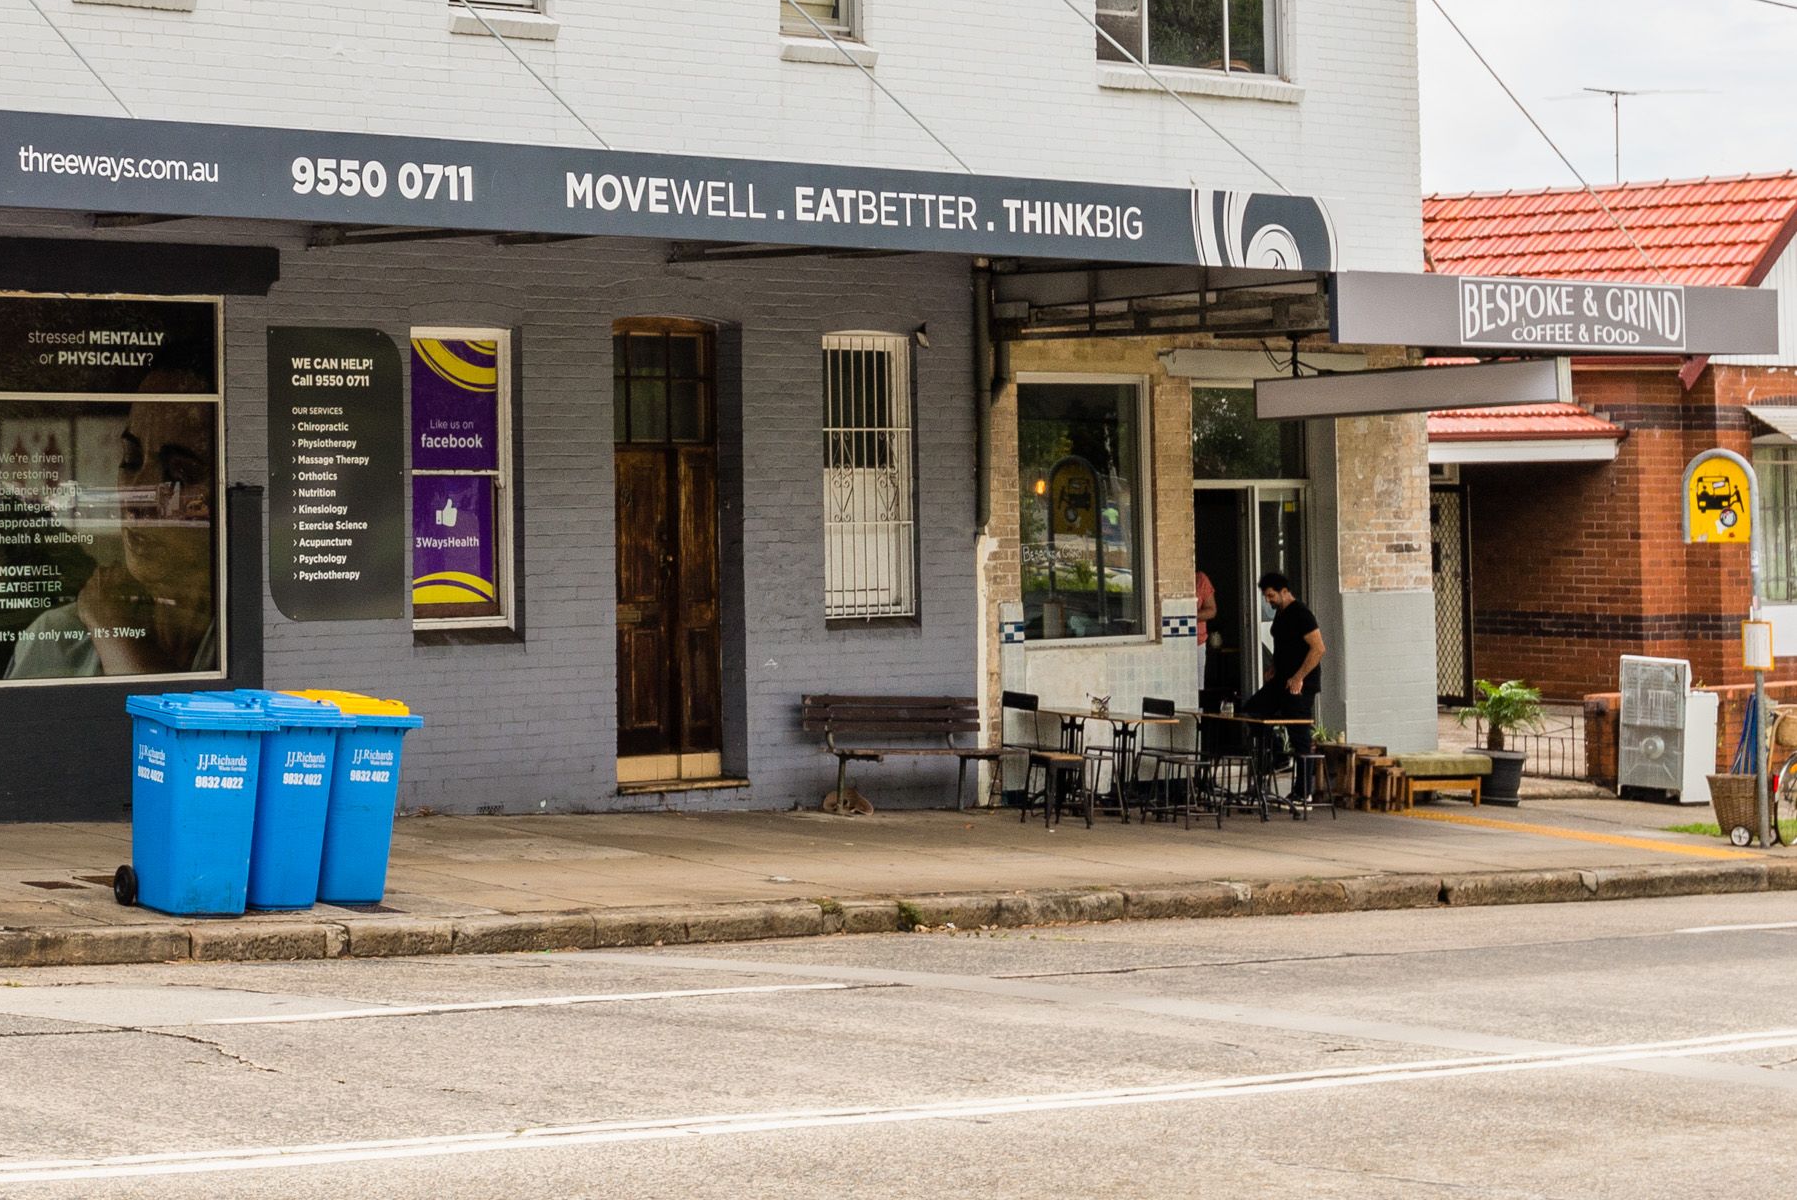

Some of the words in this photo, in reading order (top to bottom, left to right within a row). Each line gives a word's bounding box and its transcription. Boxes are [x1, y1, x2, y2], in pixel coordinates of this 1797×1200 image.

[18, 145, 219, 182] threeways.com.au
[291, 156, 387, 198] 9550
[398, 163, 473, 201] 0711
[566, 172, 766, 219] MOVEWELL
[796, 186, 977, 231] EATBETTER
[1003, 200, 1143, 240] THINKBIG
[1464, 283, 1575, 339] BESPOKE
[1583, 287, 1599, 317] &
[1605, 288, 1681, 342] GRIND
[28, 330, 85, 344] stressed
[89, 331, 164, 346] MENTALLY
[1512, 323, 1573, 342] COFFEE
[1579, 323, 1589, 343] &
[1594, 325, 1640, 344] FOOD
[39, 353, 54, 365] or
[58, 351, 154, 367] PHYSICALLY?
[291, 357, 311, 369] WE
[313, 358, 338, 369] CAN
[341, 358, 373, 370] HELP!
[291, 374, 313, 386] Call
[315, 375, 344, 387] 9550
[346, 375, 370, 387] 0711
[291, 406, 308, 415] OUR
[309, 406, 343, 415] SERVICES
[297, 421, 349, 433] Chiropractic
[429, 419, 448, 430] Like
[450, 421, 460, 430] us
[462, 420, 474, 430] on
[297, 438, 357, 450] Physiotherapy
[421, 433, 483, 449] facebook
[31, 452, 64, 463] driven
[298, 455, 334, 466] Massage
[335, 455, 370, 466] Therapy
[12, 469, 59, 481] restoring
[298, 471, 338, 481] Orthotics
[298, 488, 337, 498] Nutrition
[298, 504, 348, 516] Kinesiology
[50, 518, 62, 528] to
[298, 520, 334, 531] Exercise
[335, 520, 368, 530] Science
[34, 533, 42, 543] &
[44, 532, 94, 545] wellbeing
[298, 537, 353, 549] Acupuncture
[415, 536, 480, 550] 3WaysHealth
[299, 553, 347, 566] Psychology
[0, 564, 62, 577] MOVEWELL
[299, 570, 361, 582] Psychotherapy
[0, 580, 62, 593] EATBETTER
[0, 597, 52, 609] THINKBIG
[0, 631, 15, 642] It's
[18, 630, 35, 641] the
[38, 629, 61, 642] only
[64, 629, 84, 642] way
[94, 628, 110, 639] It's
[112, 627, 146, 640] 3Ways
[195, 775, 220, 789] 9832
[221, 777, 244, 789] 4022
[304, 773, 322, 786] 4022
[371, 770, 390, 783] 4022
